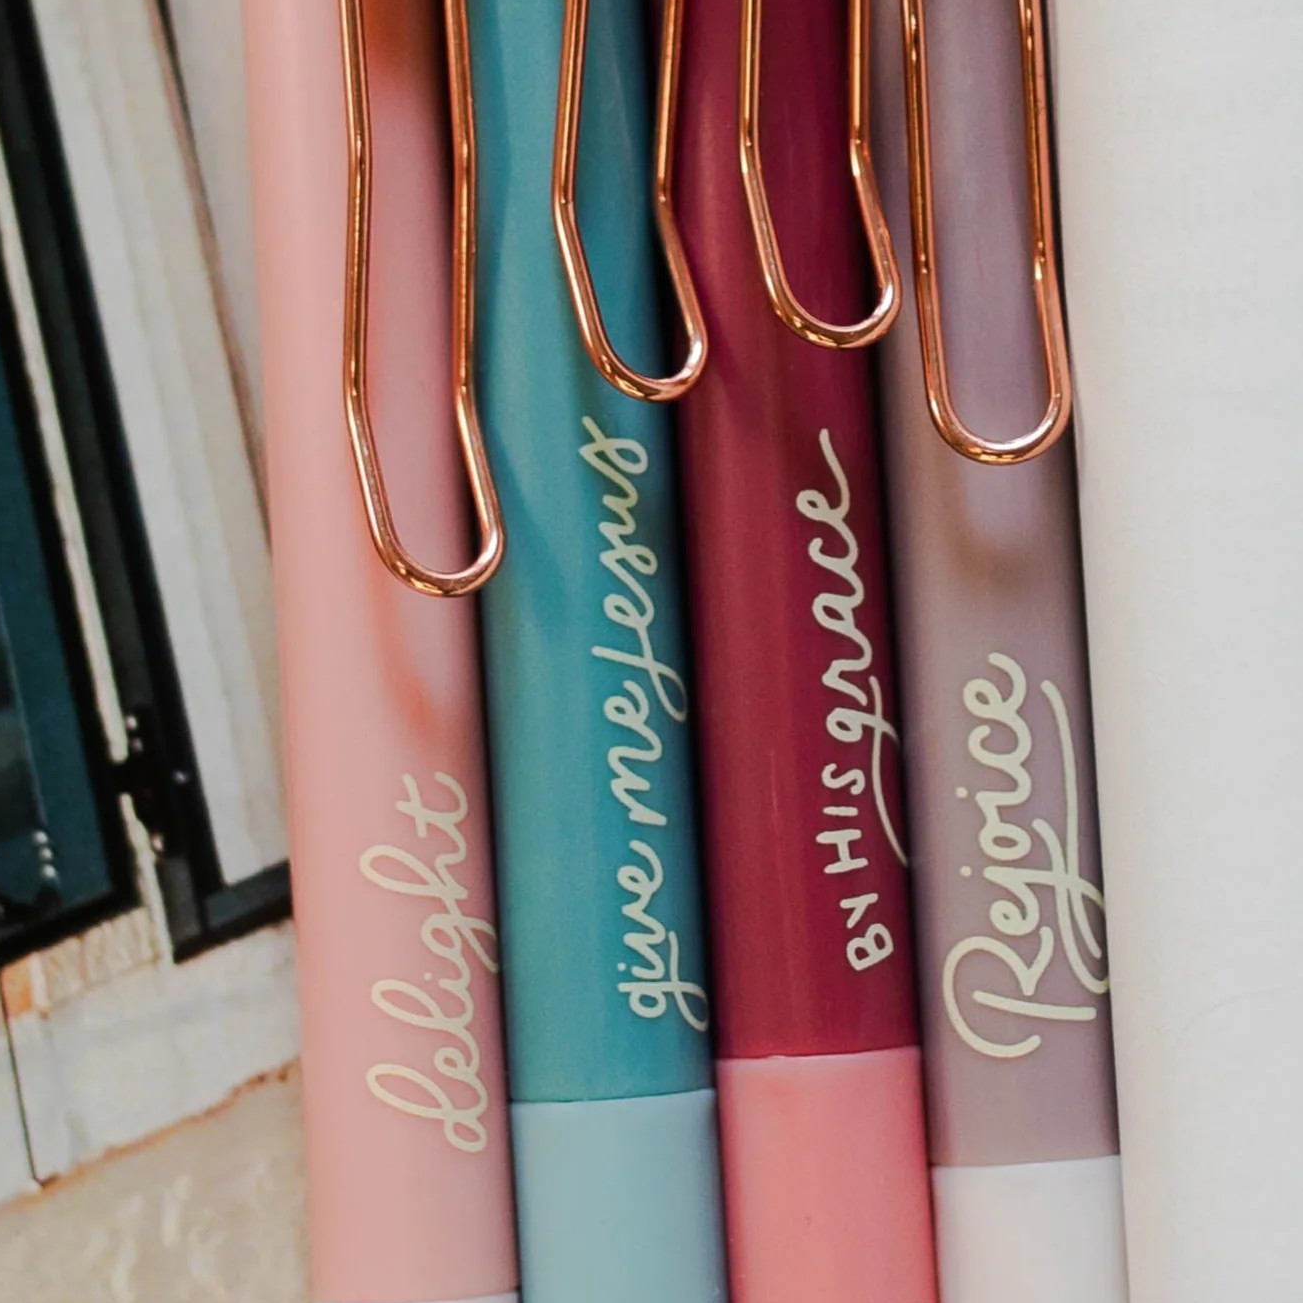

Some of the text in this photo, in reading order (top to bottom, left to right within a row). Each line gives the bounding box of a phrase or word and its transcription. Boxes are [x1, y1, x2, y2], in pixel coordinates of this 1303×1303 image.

[579, 415, 708, 1031] give me Jesus
[796, 428, 909, 971] BY HIS grace
[942, 652, 1110, 1058] Rejoice
[360, 770, 498, 1153] delight
